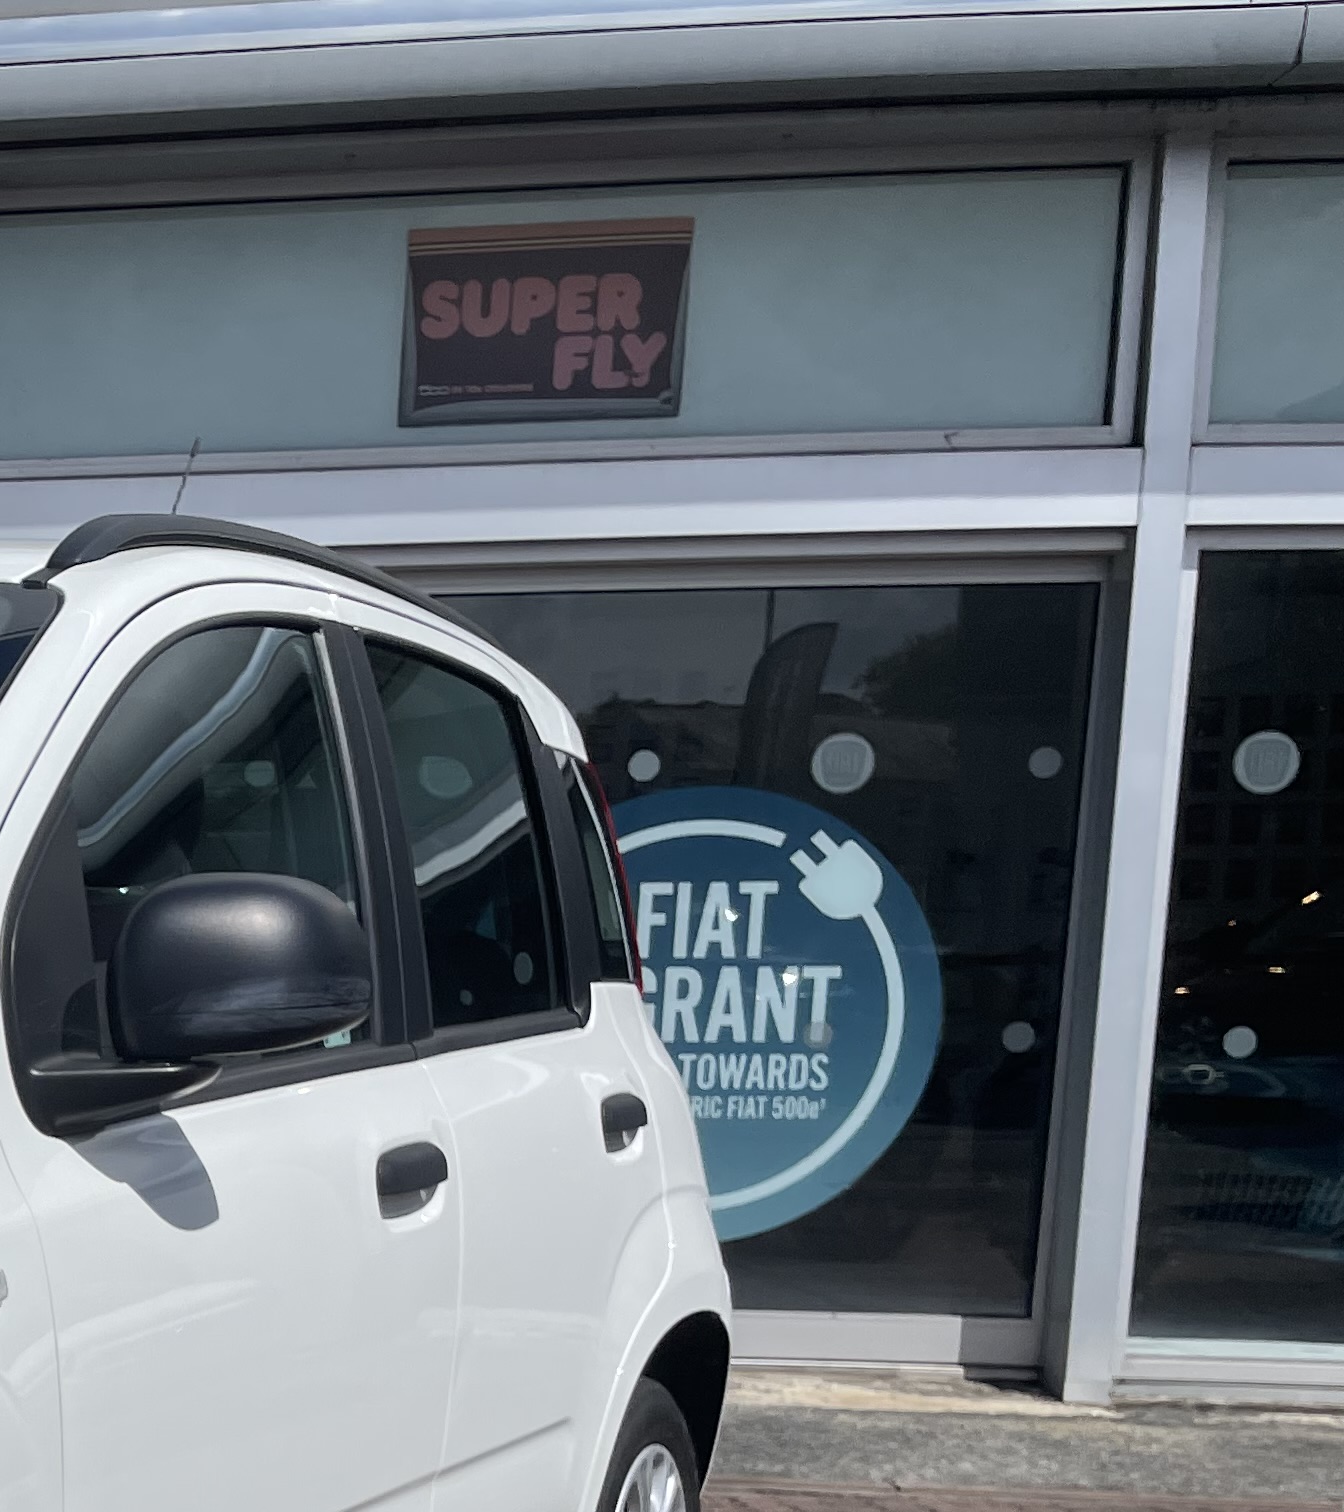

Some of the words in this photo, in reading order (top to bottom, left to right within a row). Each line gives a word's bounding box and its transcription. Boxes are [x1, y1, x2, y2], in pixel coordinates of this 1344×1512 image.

[420, 273, 643, 340] SUPER
[552, 331, 667, 391] FLY
[637, 880, 780, 960] FIAT
[677, 1052, 830, 1092] TOWARDS
[690, 1095, 724, 1120] RIC
[726, 1095, 769, 1120] FIAT
